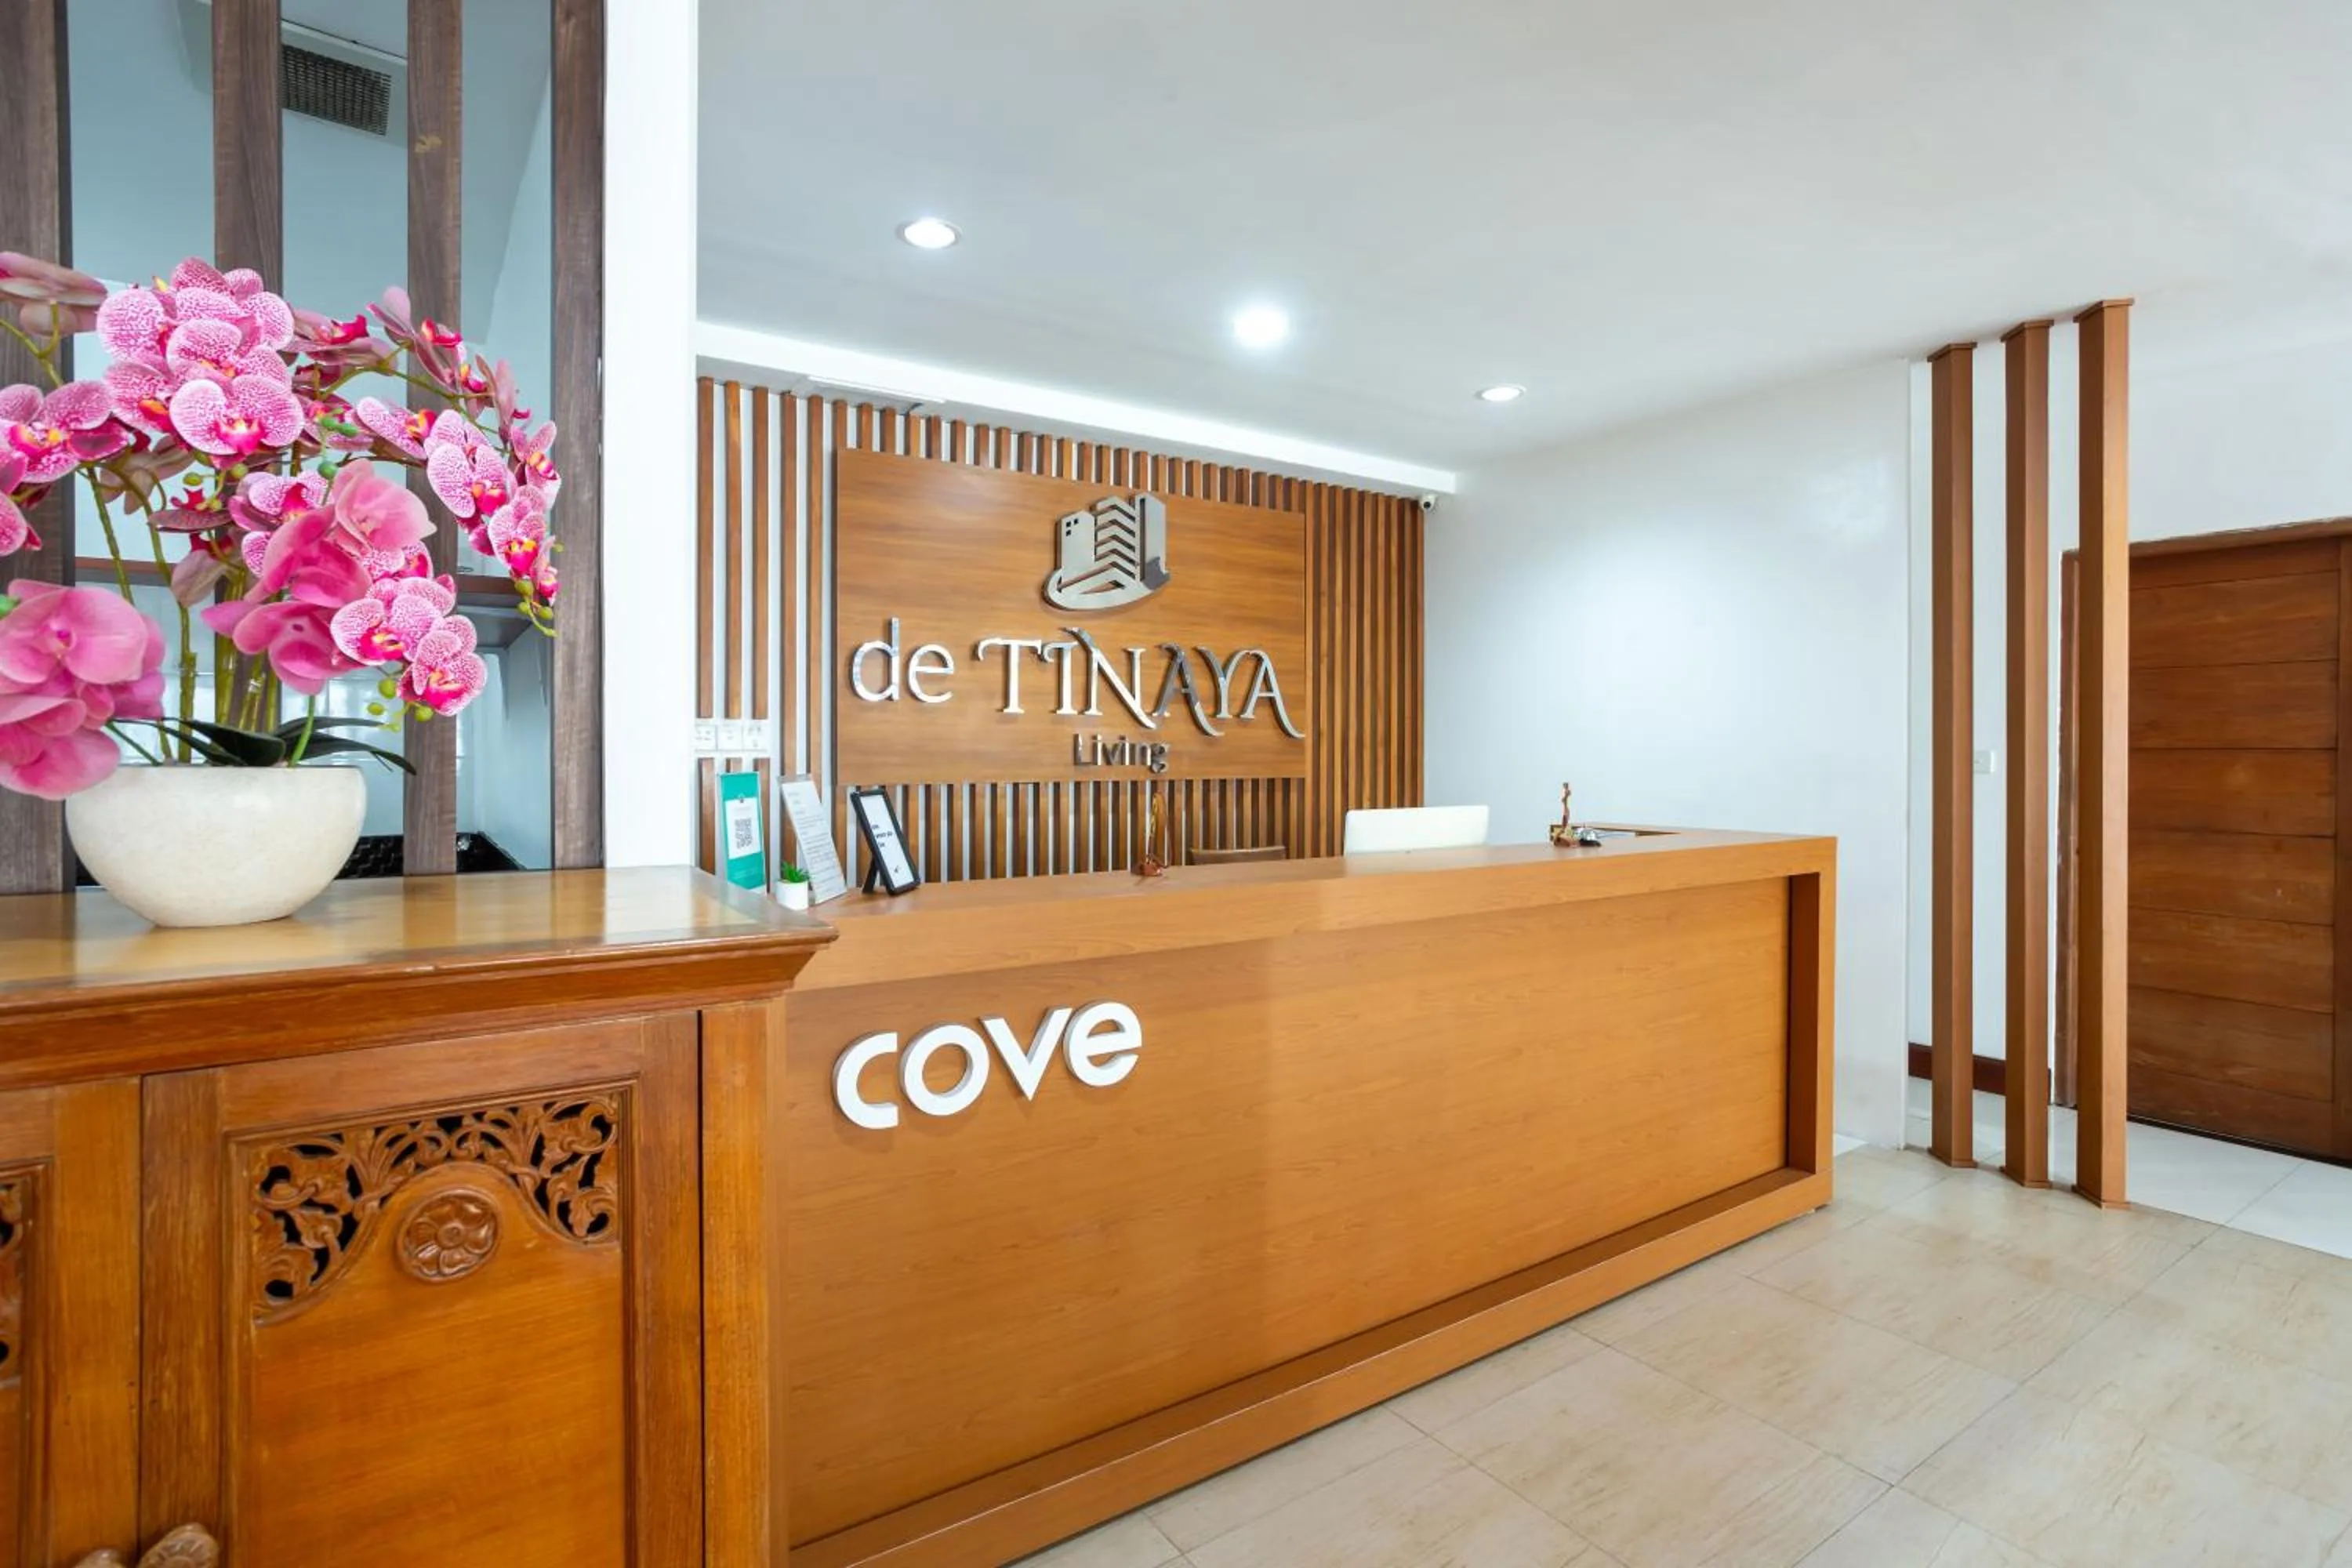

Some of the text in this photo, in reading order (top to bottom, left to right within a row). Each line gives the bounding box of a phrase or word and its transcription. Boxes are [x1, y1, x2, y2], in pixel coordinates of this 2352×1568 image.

[851, 617, 1306, 739] de TINAYA
[1074, 733, 1171, 774] Living
[832, 1000, 1143, 1130] cove
